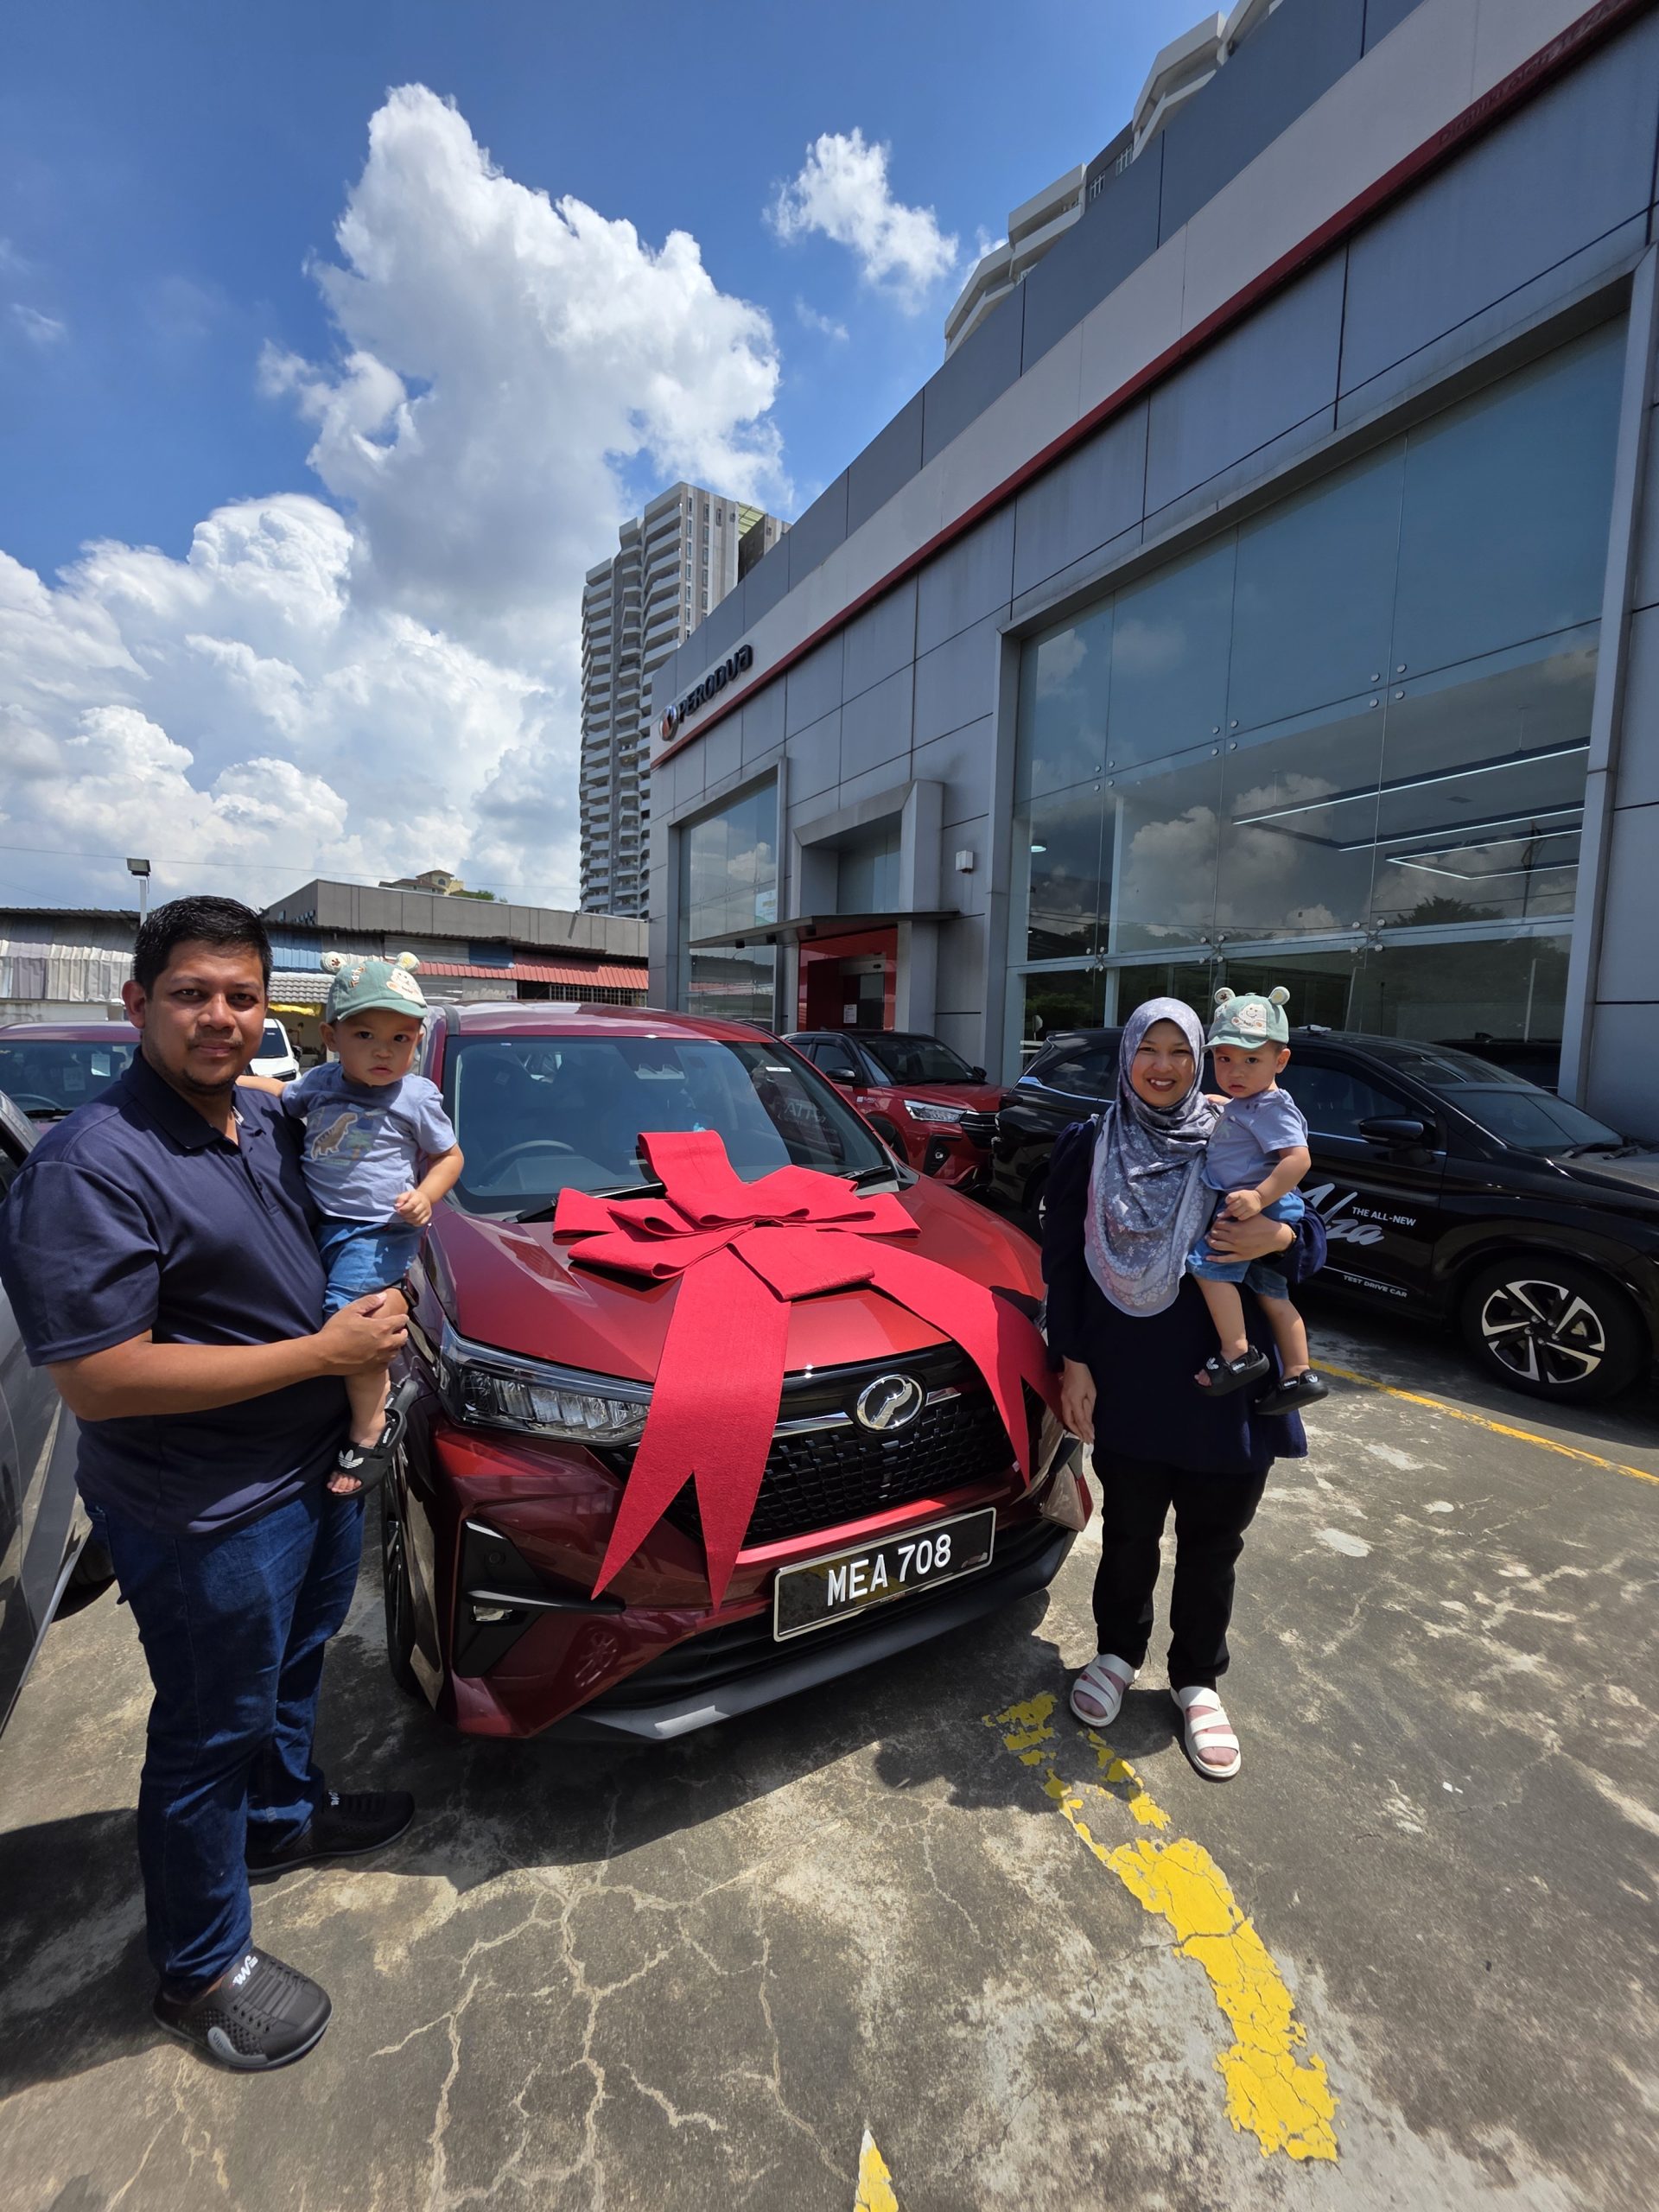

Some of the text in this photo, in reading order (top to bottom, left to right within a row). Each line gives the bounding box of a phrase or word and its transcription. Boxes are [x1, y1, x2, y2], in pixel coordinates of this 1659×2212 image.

[678, 644, 753, 723] PERODUA
[1352, 1206, 1417, 1226] THE ALL-NEW
[1343, 1274, 1408, 1298] TEST DRIVE CAR
[827, 1534, 951, 1606] MEA 708
